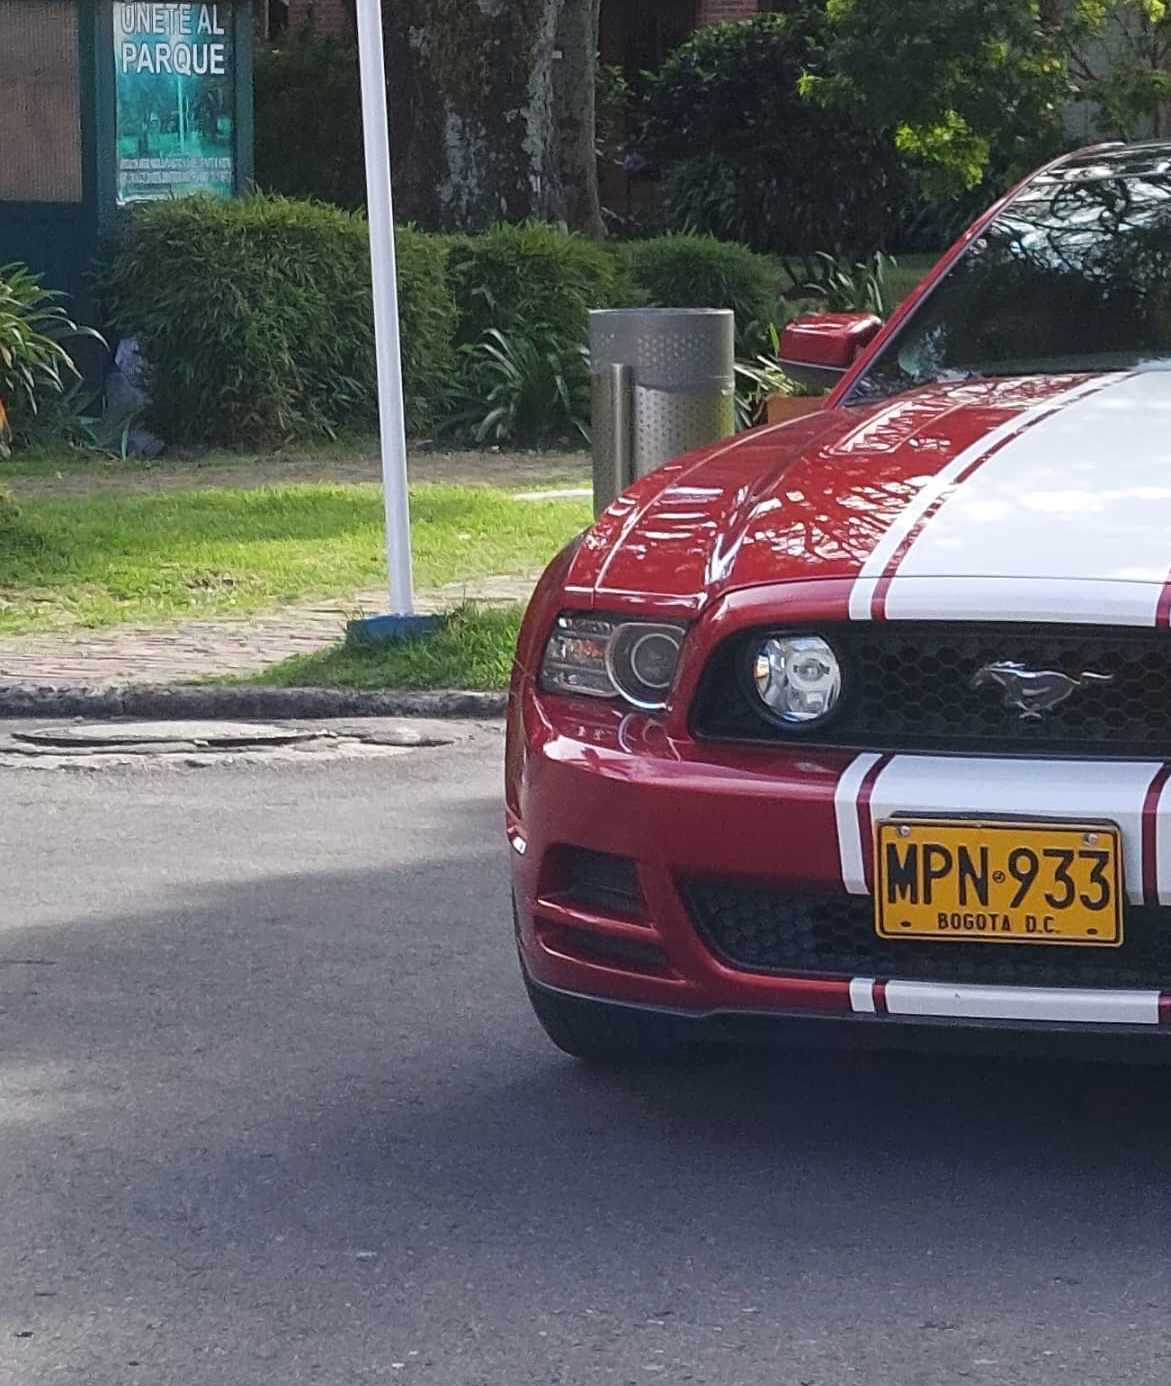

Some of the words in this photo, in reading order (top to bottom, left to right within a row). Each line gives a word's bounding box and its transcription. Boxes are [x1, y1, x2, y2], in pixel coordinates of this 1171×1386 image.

[197, 3, 225, 35] AL
[121, 43, 225, 76] PARQUE
[937, 912, 1011, 933] BOGOTA
